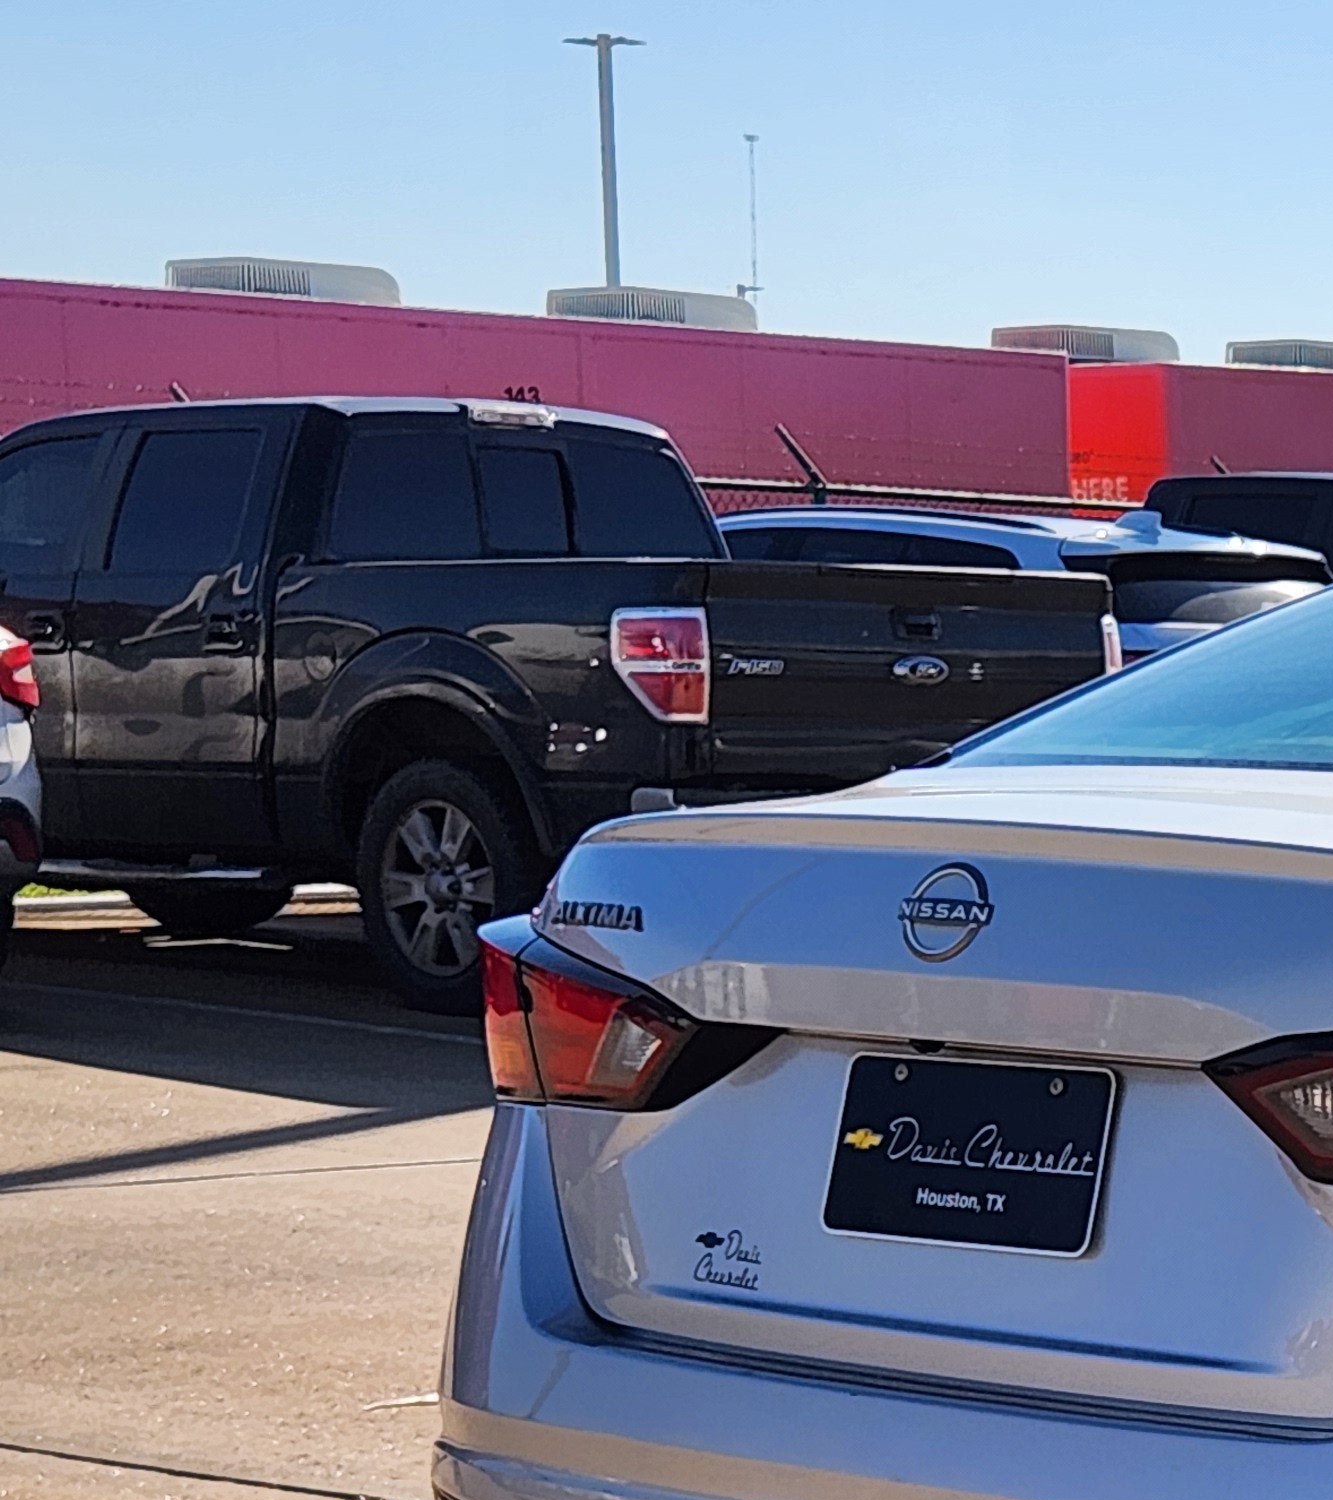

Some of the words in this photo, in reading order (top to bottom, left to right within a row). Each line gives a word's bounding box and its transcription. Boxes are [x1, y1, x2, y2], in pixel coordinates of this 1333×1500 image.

[1071, 477, 1128, 502] HERE
[901, 900, 989, 922] NISSAN
[886, 1116, 961, 1166] Davis
[964, 1123, 1094, 1176] Chevrolet
[916, 1187, 981, 1213] Houston,
[986, 1193, 1006, 1212] TX
